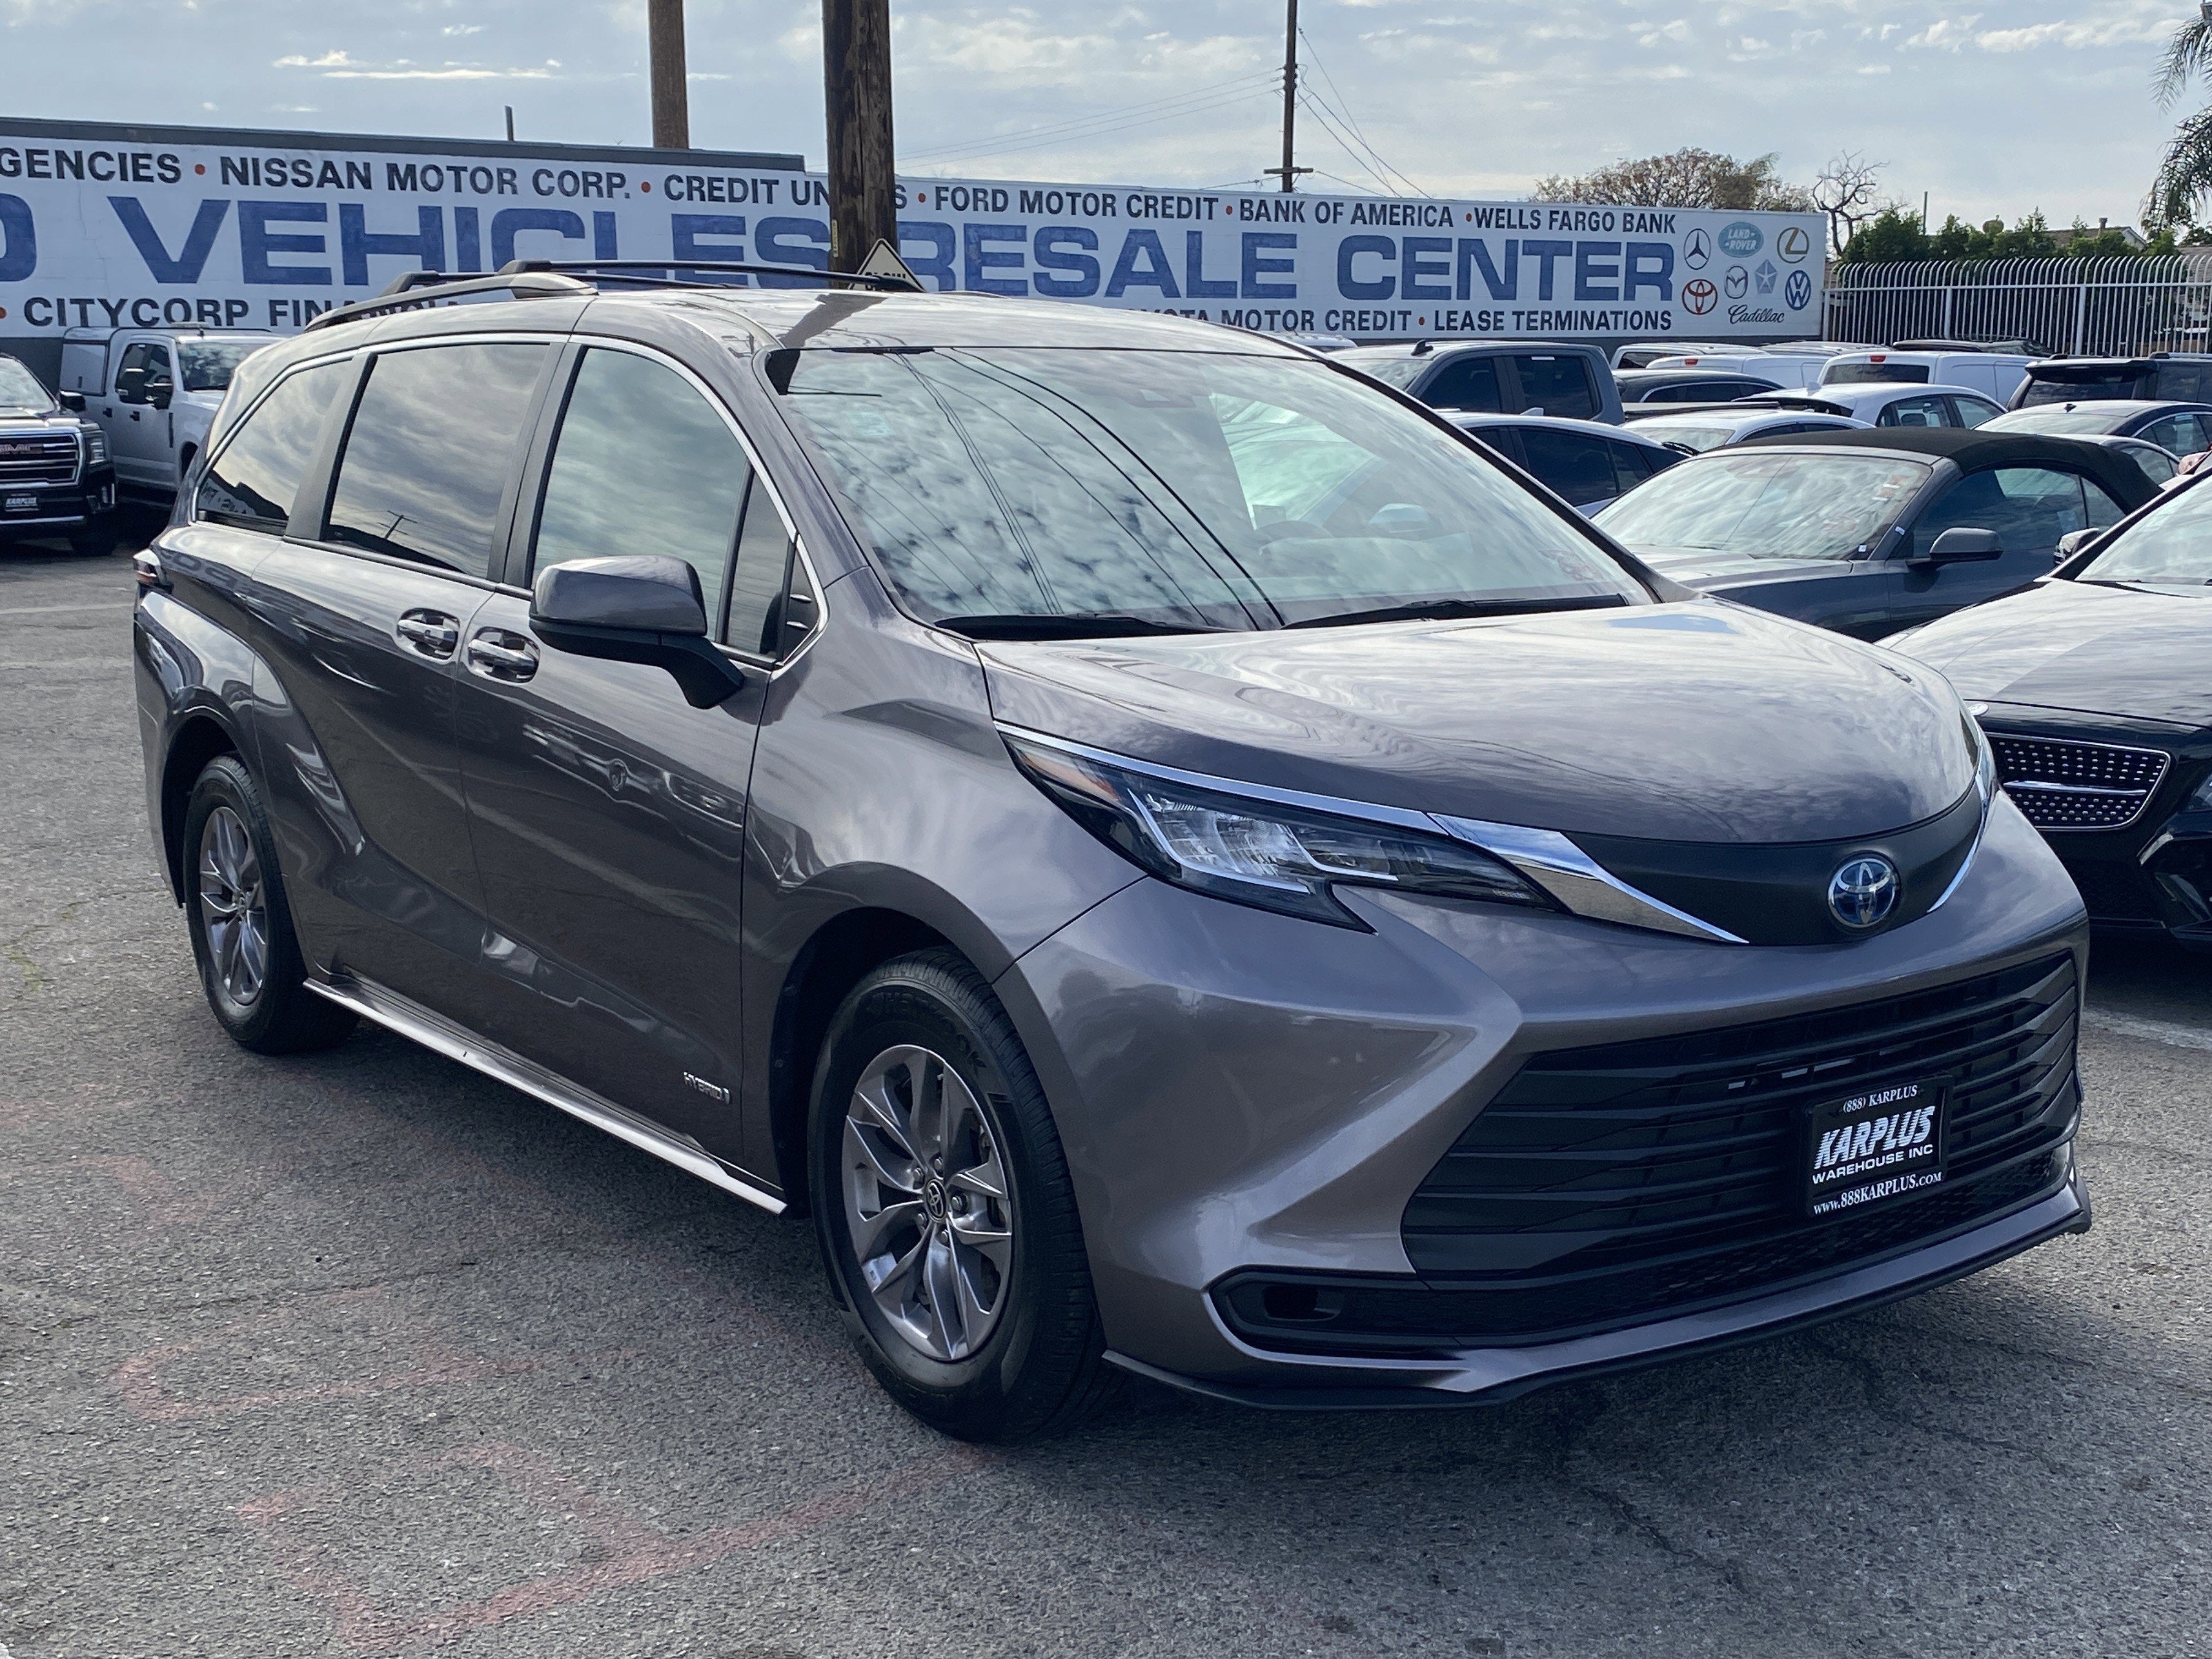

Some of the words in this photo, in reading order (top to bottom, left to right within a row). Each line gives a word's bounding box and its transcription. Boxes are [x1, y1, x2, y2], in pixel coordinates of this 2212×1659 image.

[220, 156, 372, 190] NISSAN
[387, 163, 518, 195] MOTOR
[533, 168, 631, 199] CORP.
[664, 174, 779, 205] CREDIT
[935, 186, 1010, 212] FORD
[1020, 189, 1116, 216] MOTOR
[1126, 194, 1218, 220] CREDIT
[1240, 199, 1305, 223] BANK
[1315, 201, 1343, 224] OF
[1350, 203, 1454, 228] AMERICA
[1474, 207, 1541, 229] WELLS
[1549, 211, 1615, 232] FARGO
[1623, 213, 1676, 234] BANK
[896, 220, 1297, 298] RESALE
[1337, 234, 1674, 301] CENTER
[24, 296, 249, 327] CITYCORP
[1221, 309, 1314, 331] MOTOR
[1324, 310, 1412, 331] CREDIT
[1434, 310, 1504, 331] LEASE
[1512, 310, 1672, 331] TERMINATIONS
[1728, 304, 1785, 324] Cadillac
[1843, 1097, 1866, 1113] (888)
[1868, 1084, 1918, 1107] KARPLUS
[1813, 1105, 1936, 1170] KARPLUS
[1812, 1151, 1904, 1185] WAREHOUSE
[1909, 1144, 1933, 1159] INC
